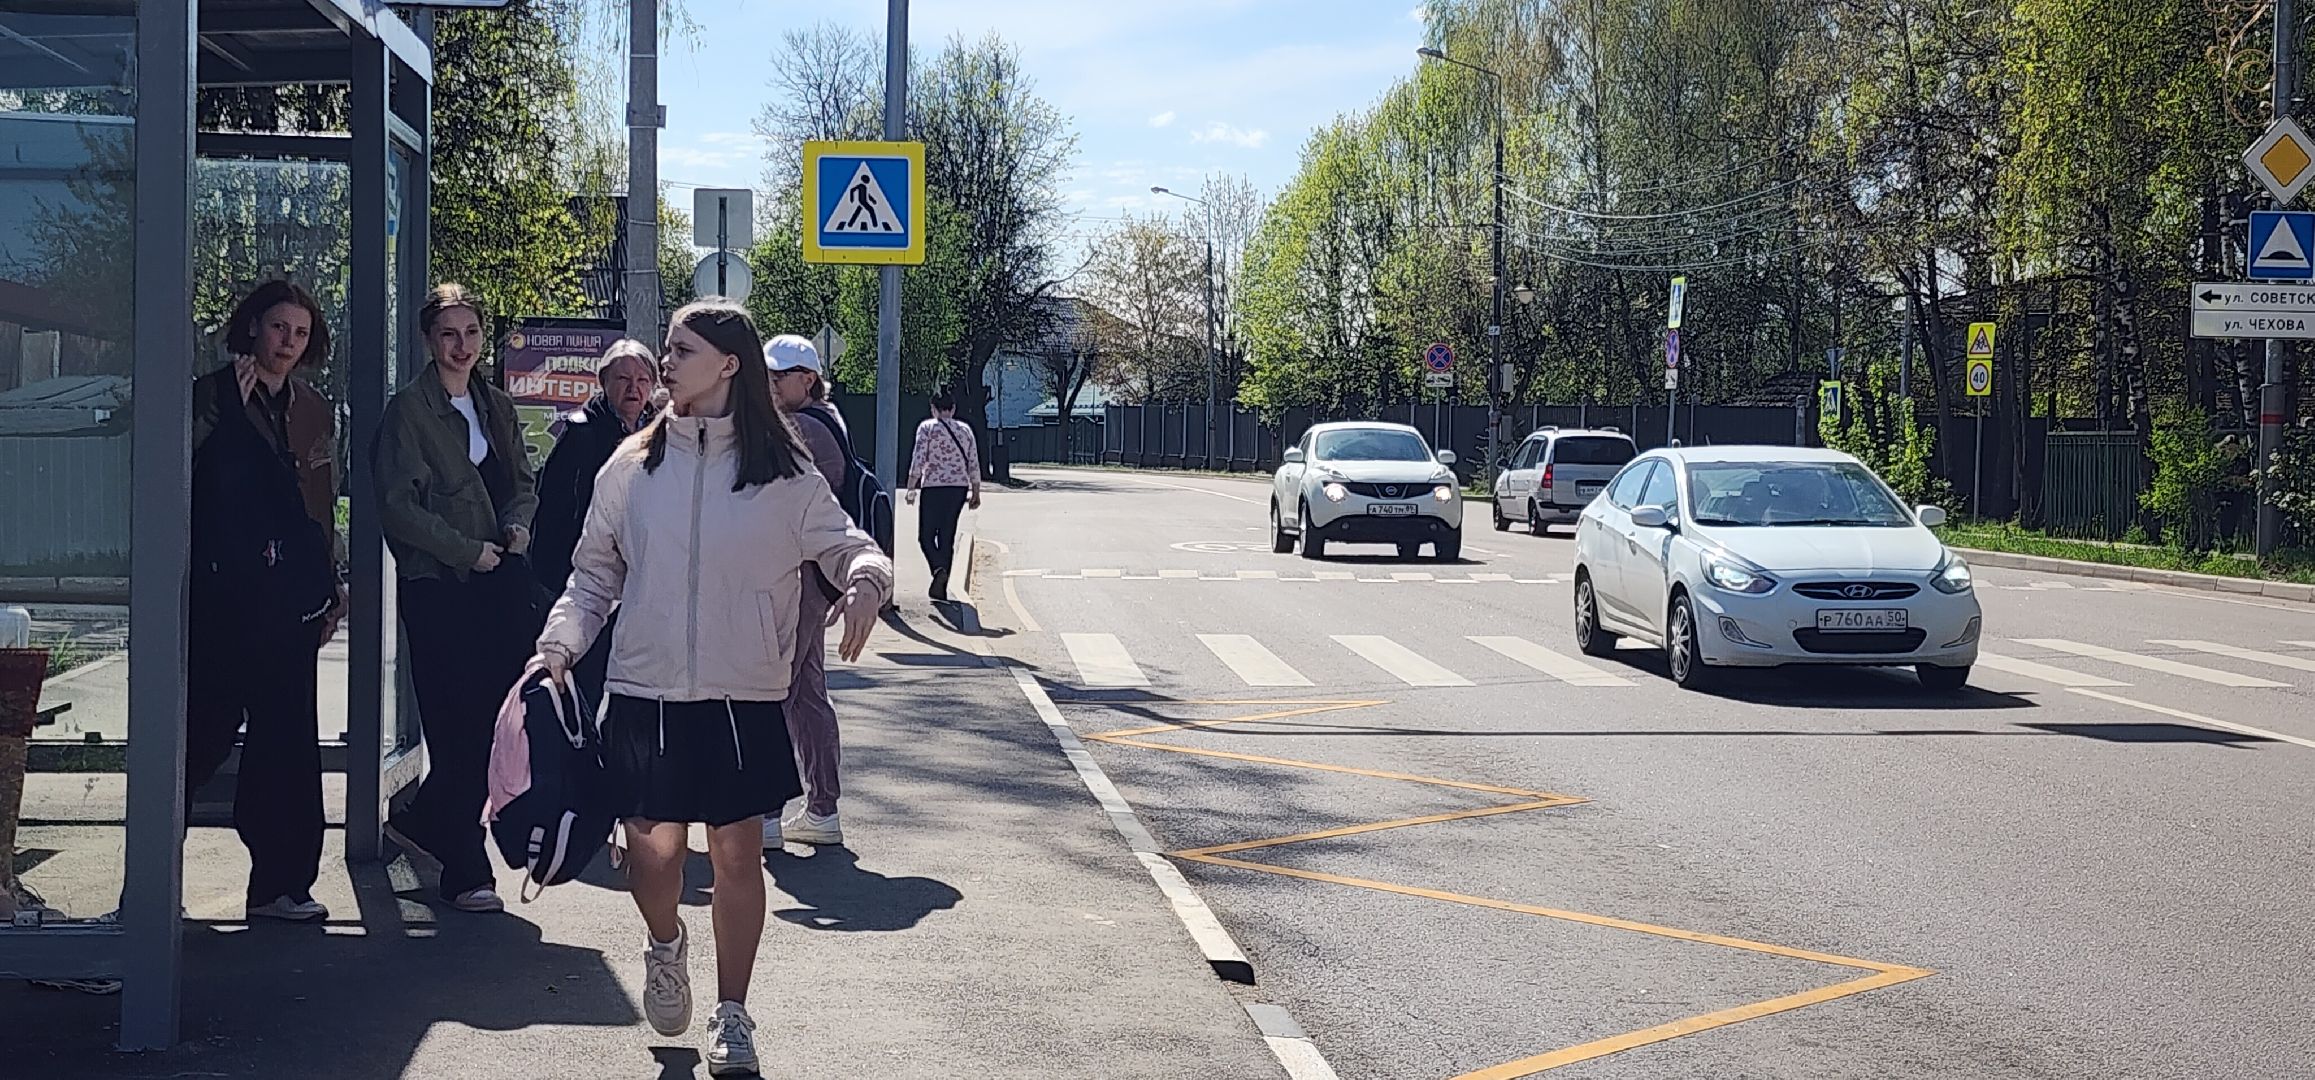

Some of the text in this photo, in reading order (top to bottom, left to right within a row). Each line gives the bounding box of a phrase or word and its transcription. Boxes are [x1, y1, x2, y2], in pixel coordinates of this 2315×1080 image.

[2224, 294, 2244, 306] ул.
[2224, 318, 2305, 331] ул. ЧЕХОВА
[1972, 371, 1985, 384] 40
